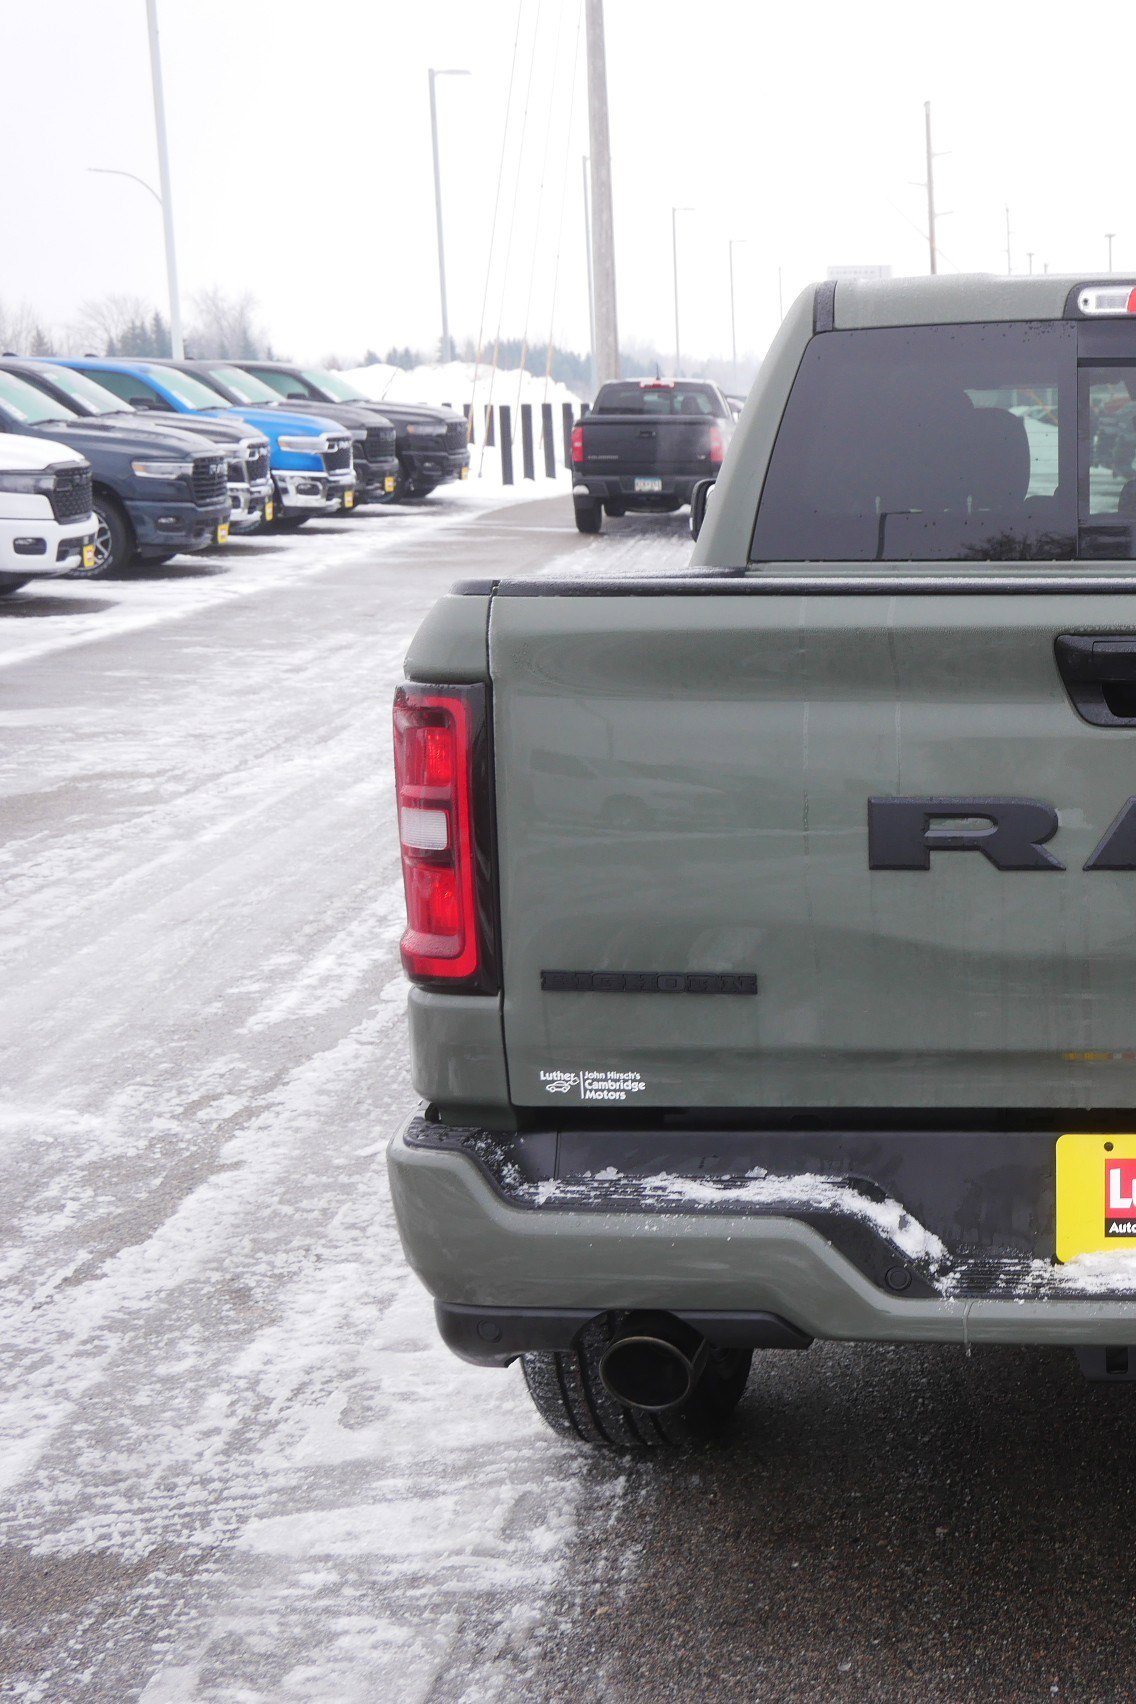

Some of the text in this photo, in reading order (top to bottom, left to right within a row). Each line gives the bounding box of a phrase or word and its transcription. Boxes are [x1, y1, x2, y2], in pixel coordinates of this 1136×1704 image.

[540, 1070, 576, 1081] Luther
[584, 1071, 641, 1080] John Hirsch's
[584, 1079, 646, 1092] Cambridge
[584, 1090, 627, 1100] Motors
